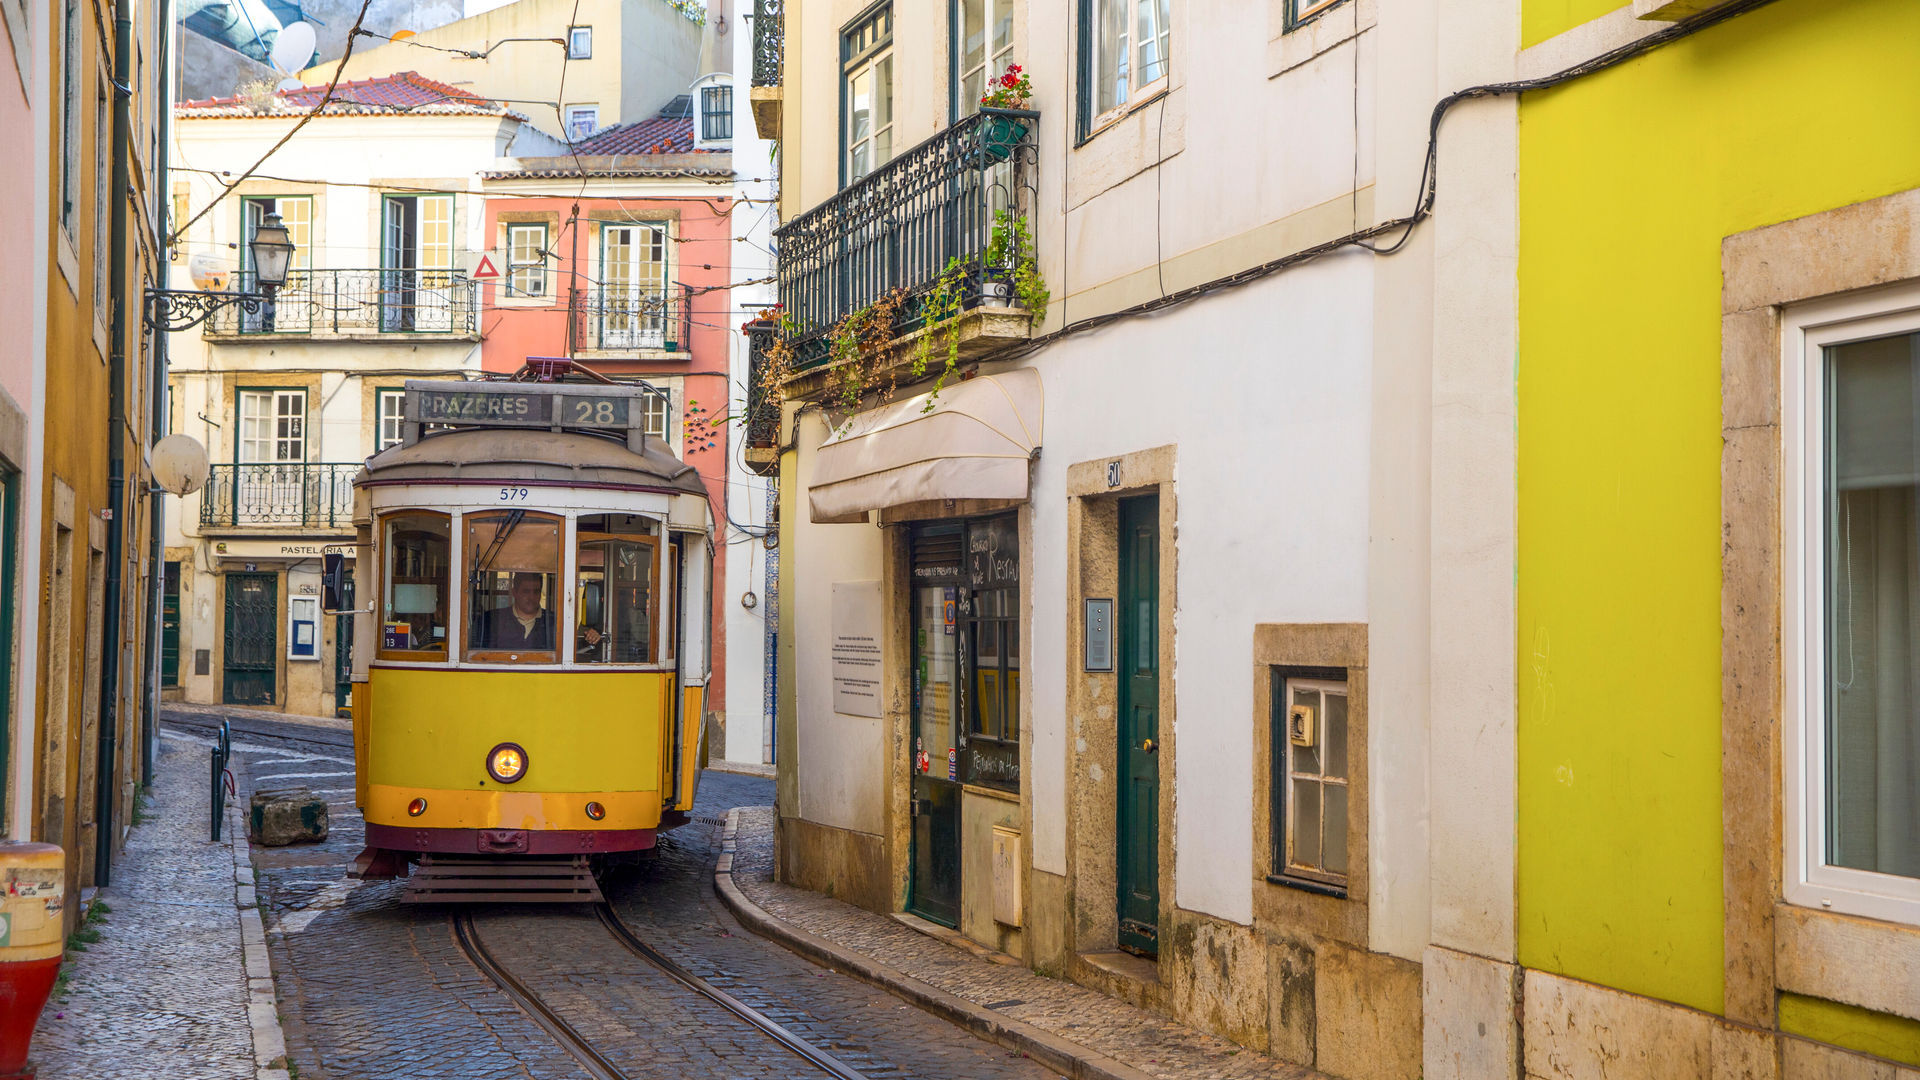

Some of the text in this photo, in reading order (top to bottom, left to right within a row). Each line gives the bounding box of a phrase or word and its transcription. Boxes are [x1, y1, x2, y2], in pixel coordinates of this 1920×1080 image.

[576, 401, 615, 425] 28
[1108, 462, 1120, 486] 50
[500, 488, 528, 501] 579
[386, 638, 395, 647] 13
